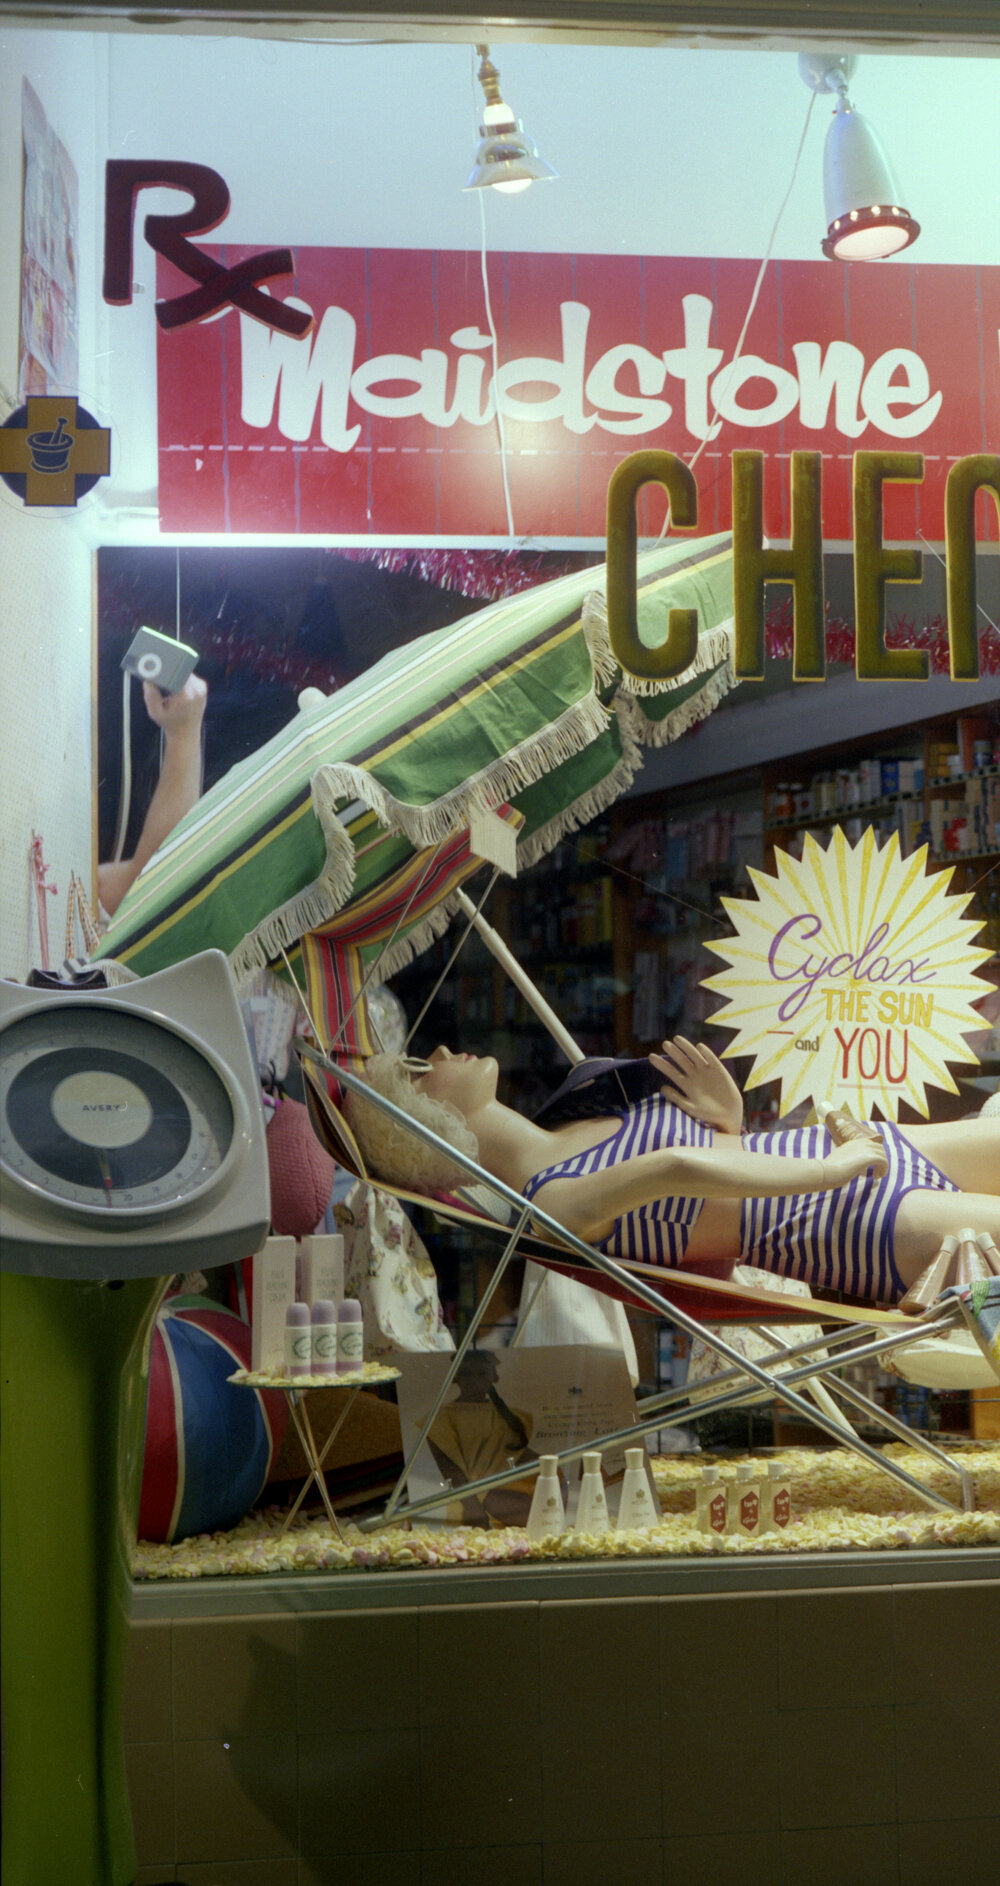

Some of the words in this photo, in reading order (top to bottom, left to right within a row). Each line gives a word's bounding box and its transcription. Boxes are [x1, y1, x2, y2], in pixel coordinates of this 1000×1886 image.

[225, 285, 942, 454] Maidstone
[768, 914, 937, 1021] Cyclax
[821, 989, 871, 1023] THE
[878, 991, 934, 1027] SUN
[795, 1036, 820, 1051] and
[834, 1027, 908, 1084] YOU
